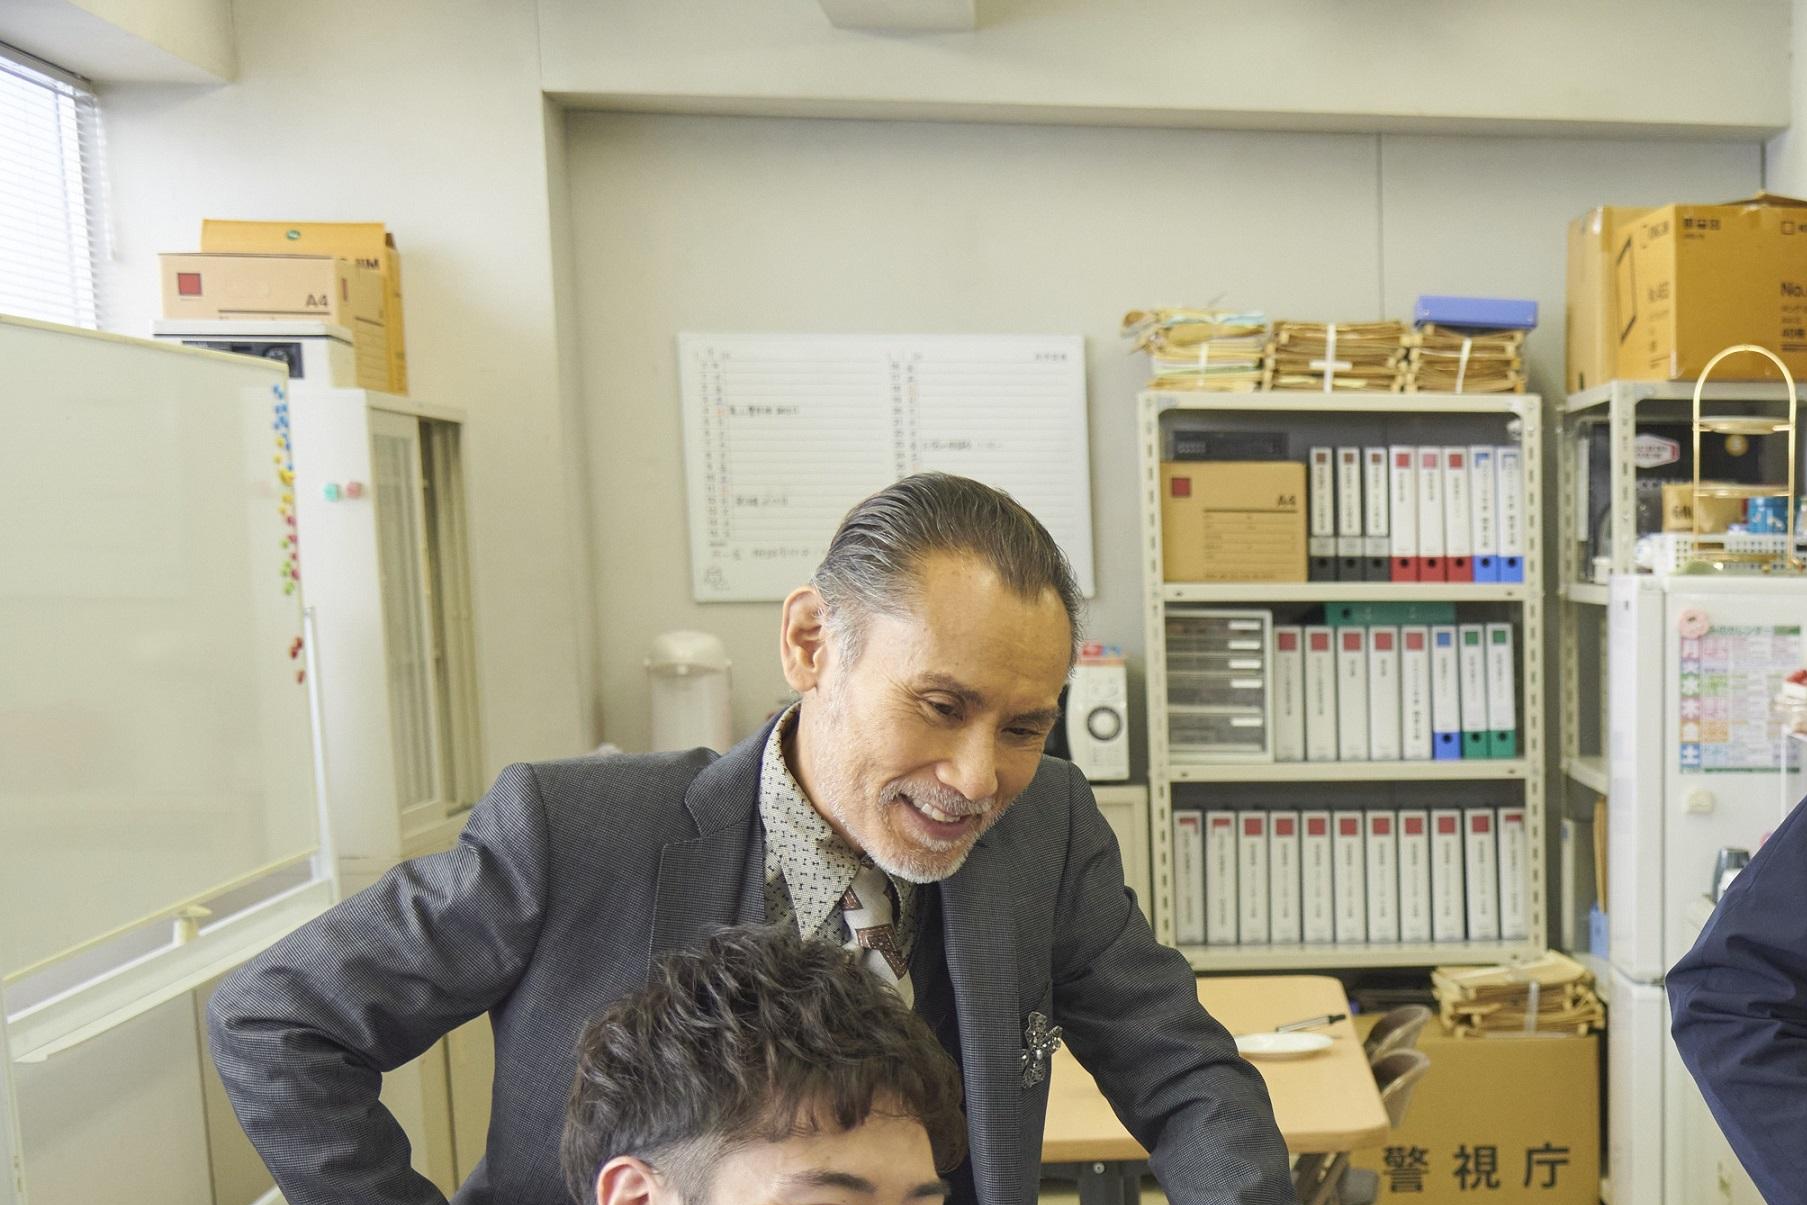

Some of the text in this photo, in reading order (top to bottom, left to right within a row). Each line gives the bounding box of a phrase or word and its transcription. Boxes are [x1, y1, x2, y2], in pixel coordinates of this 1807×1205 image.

[306, 294, 329, 306] A4
[1383, 1141, 1570, 1193] 警視庁
